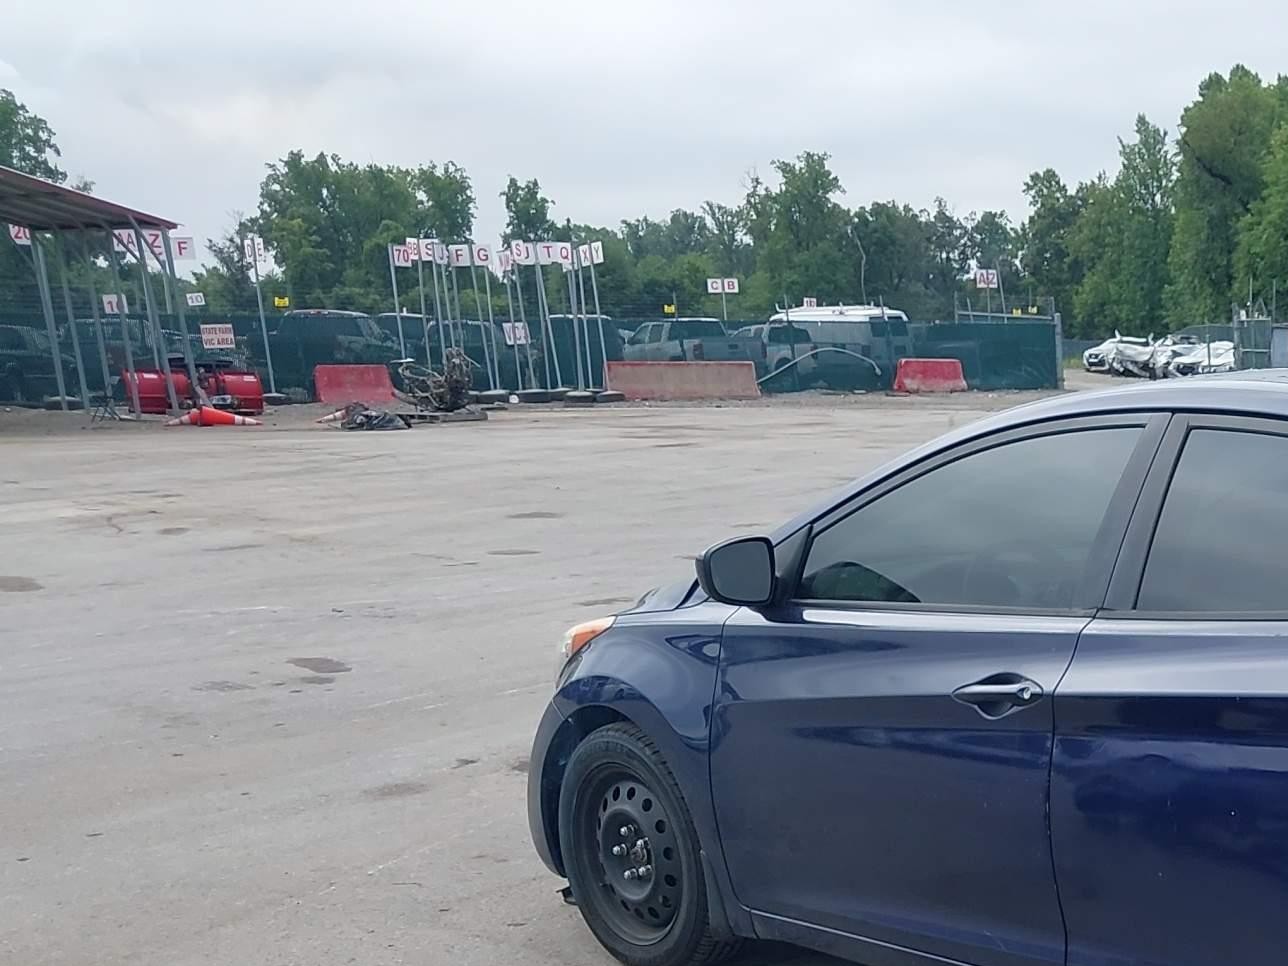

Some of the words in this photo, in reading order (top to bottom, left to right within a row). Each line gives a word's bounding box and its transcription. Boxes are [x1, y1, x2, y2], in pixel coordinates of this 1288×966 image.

[177, 241, 187, 256] F
[395, 248, 410, 262] 70
[455, 248, 463, 262] F
[477, 247, 489, 261] G
[543, 246, 552, 258] T
[560, 246, 569, 260] Q
[711, 281, 718, 290] C
[727, 281, 735, 290] B
[202, 327, 218, 335] STATE
[217, 337, 234, 346] AREA
